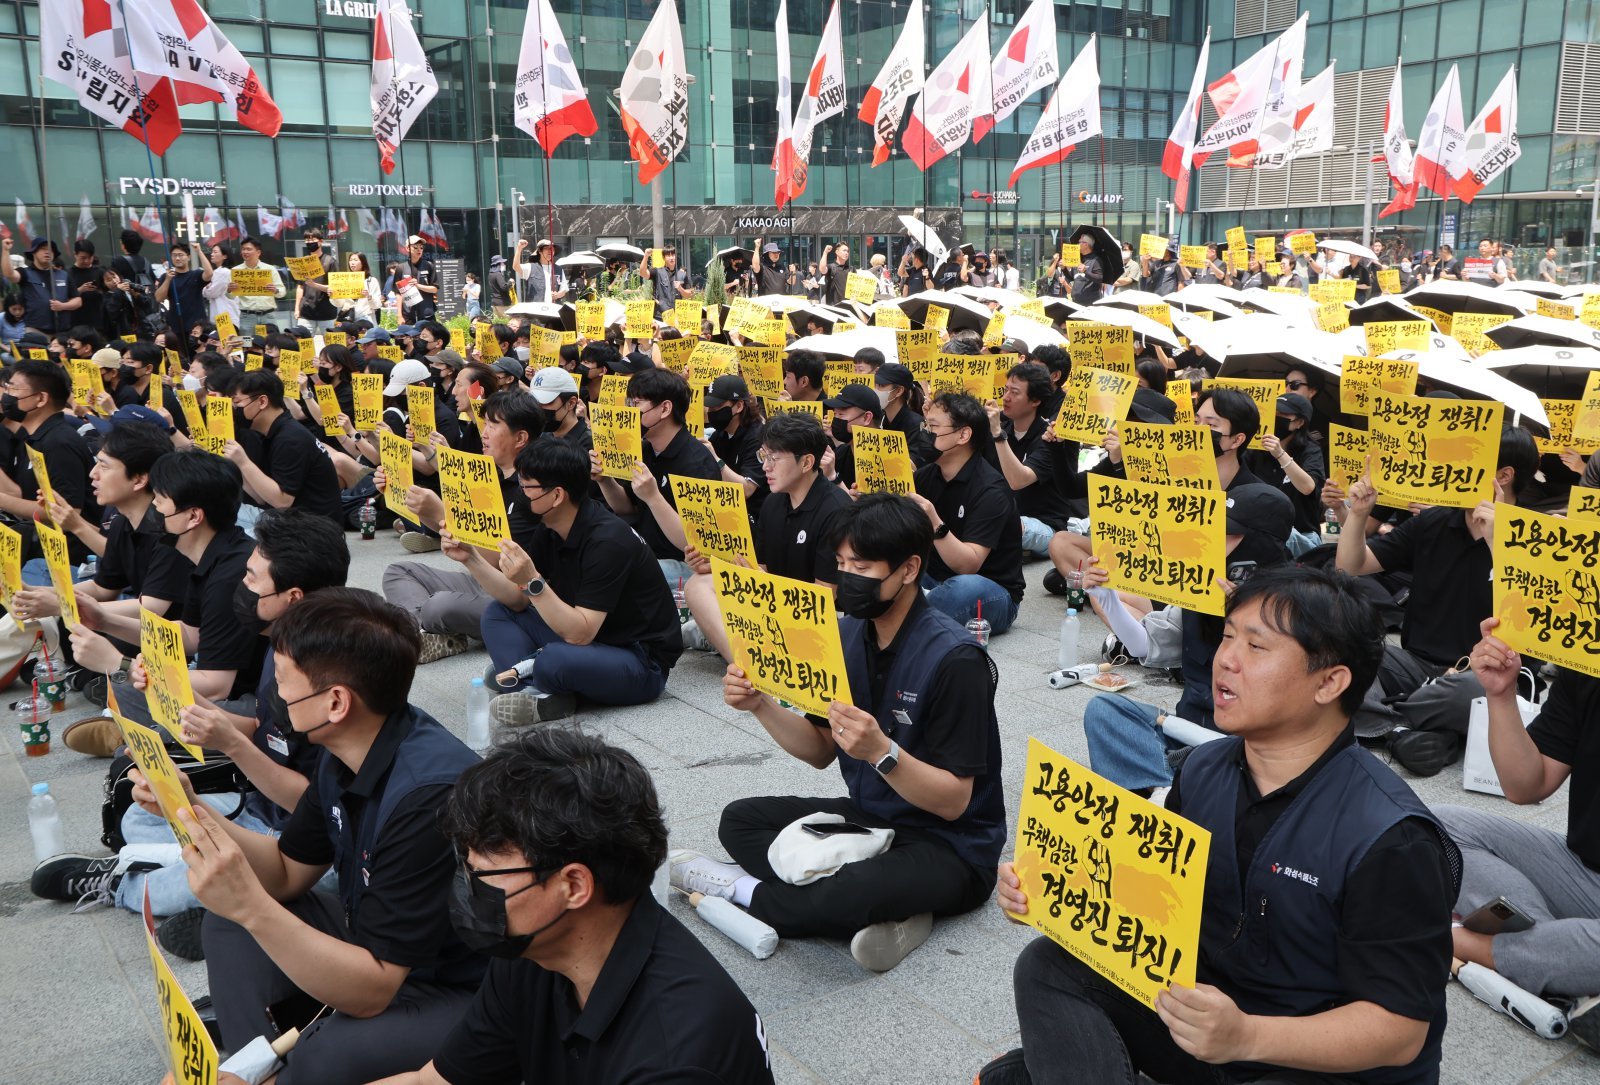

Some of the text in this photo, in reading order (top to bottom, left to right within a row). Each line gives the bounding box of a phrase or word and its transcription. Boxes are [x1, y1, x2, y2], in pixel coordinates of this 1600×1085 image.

[325, 0, 344, 16] LA
[120, 177, 179, 195] FYSD
[181, 178, 216, 188] flower
[192, 188, 216, 196] cake
[350, 184, 423, 196] RED TONGUE
[993, 191, 1017, 199] CUCHARA
[1084, 194, 1122, 203] SALADY
[738, 217, 797, 228] KAKAO AGIT
[588, 304, 603, 315] 쟁취!
[585, 324, 602, 334] 퇴진!
[739, 320, 757, 333] 퇴진!
[1368, 323, 1425, 338] 고용안정 쟁취!
[1457, 315, 1510, 328] 고용안정 쟁취!
[544, 329, 561, 343] 쟁취!
[910, 332, 932, 345] 쟁취!
[1073, 329, 1129, 344] 고용안정 쟁취!
[1460, 338, 1482, 352] 경영진
[659, 339, 696, 354] 고용안정 쟁취!
[1073, 350, 1092, 361] 무책임한
[539, 355, 557, 368] 퇴진!
[739, 350, 778, 363] 고용안정 쟁취!
[694, 368, 722, 379] 경영진 퇴진!
[912, 361, 933, 373] 퇴진!
[935, 358, 991, 376] 고용안정 쟁취!
[1346, 359, 1414, 379] 고용안정 쟁취!
[361, 377, 379, 392] 쟁취!
[750, 379, 780, 393] 경영진 퇴진!
[1096, 375, 1131, 395] 쟁취!
[1171, 382, 1187, 395] 쟁취!
[1344, 379, 1369, 393] 무책임한
[319, 388, 332, 403] 쟁취!
[419, 390, 432, 405] 쟁취!
[211, 398, 228, 417] 쟁취!
[1372, 396, 1431, 428] 고용안정
[1438, 400, 1494, 432] 쟁취!
[362, 410, 378, 425] 퇴진!
[592, 408, 636, 429] 고용안정 쟁취!
[1062, 410, 1116, 435] 경영진 퇴진!
[1174, 411, 1191, 424] 퇴진!
[593, 432, 607, 448] 무책임한
[857, 430, 903, 454] 고용안정 쟁취!
[1124, 428, 1204, 451] 고용안정 쟁취!
[1334, 431, 1369, 452] 고용안
[1370, 428, 1401, 455] 무책임한
[382, 435, 410, 464] 고용안정 쟁취!
[440, 452, 492, 482] 고용안정 쟁취!
[601, 450, 637, 469] 경영진 퇴진!
[857, 458, 873, 474] 무책임한
[1126, 456, 1152, 474] 무책임한
[1333, 455, 1363, 473] 무책임한
[1379, 455, 1486, 493] 경영진 퇴진!
[442, 483, 459, 504] 무책임한
[678, 482, 739, 507] 고용안정 쟁취!
[1096, 484, 1216, 526] 고용안정 쟁취!
[451, 506, 502, 538] 경영진 퇴진!
[682, 508, 705, 526] 무책임한
[696, 528, 748, 556] 경영진 퇴진!
[1096, 522, 1138, 548] 무책임한
[1504, 518, 1600, 568] 고용안정
[49, 537, 66, 566] 쟁취!
[1116, 550, 1215, 595] 경영진 퇴진!
[1500, 565, 1562, 604] 무책임한
[720, 570, 825, 625] 고용안정 쟁취!
[726, 612, 764, 643] 무책임한
[158, 625, 180, 661] 쟁취!
[748, 647, 796, 690] 경영진
[796, 662, 838, 702] 퇴진!
[128, 729, 171, 777] 쟁취!
[1474, 776, 1493, 786] BEAN
[1032, 762, 1196, 878] 고용안정 쟁취!
[1022, 816, 1078, 875] 무책임한
[1284, 867, 1319, 886] 화섬식품노조
[1041, 872, 1182, 988] 경영진 퇴진!
[1096, 962, 1125, 985] 화섬식품노조
[1126, 982, 1152, 1004] 카카오지회
[176, 1010, 210, 1085] 쟁취!
